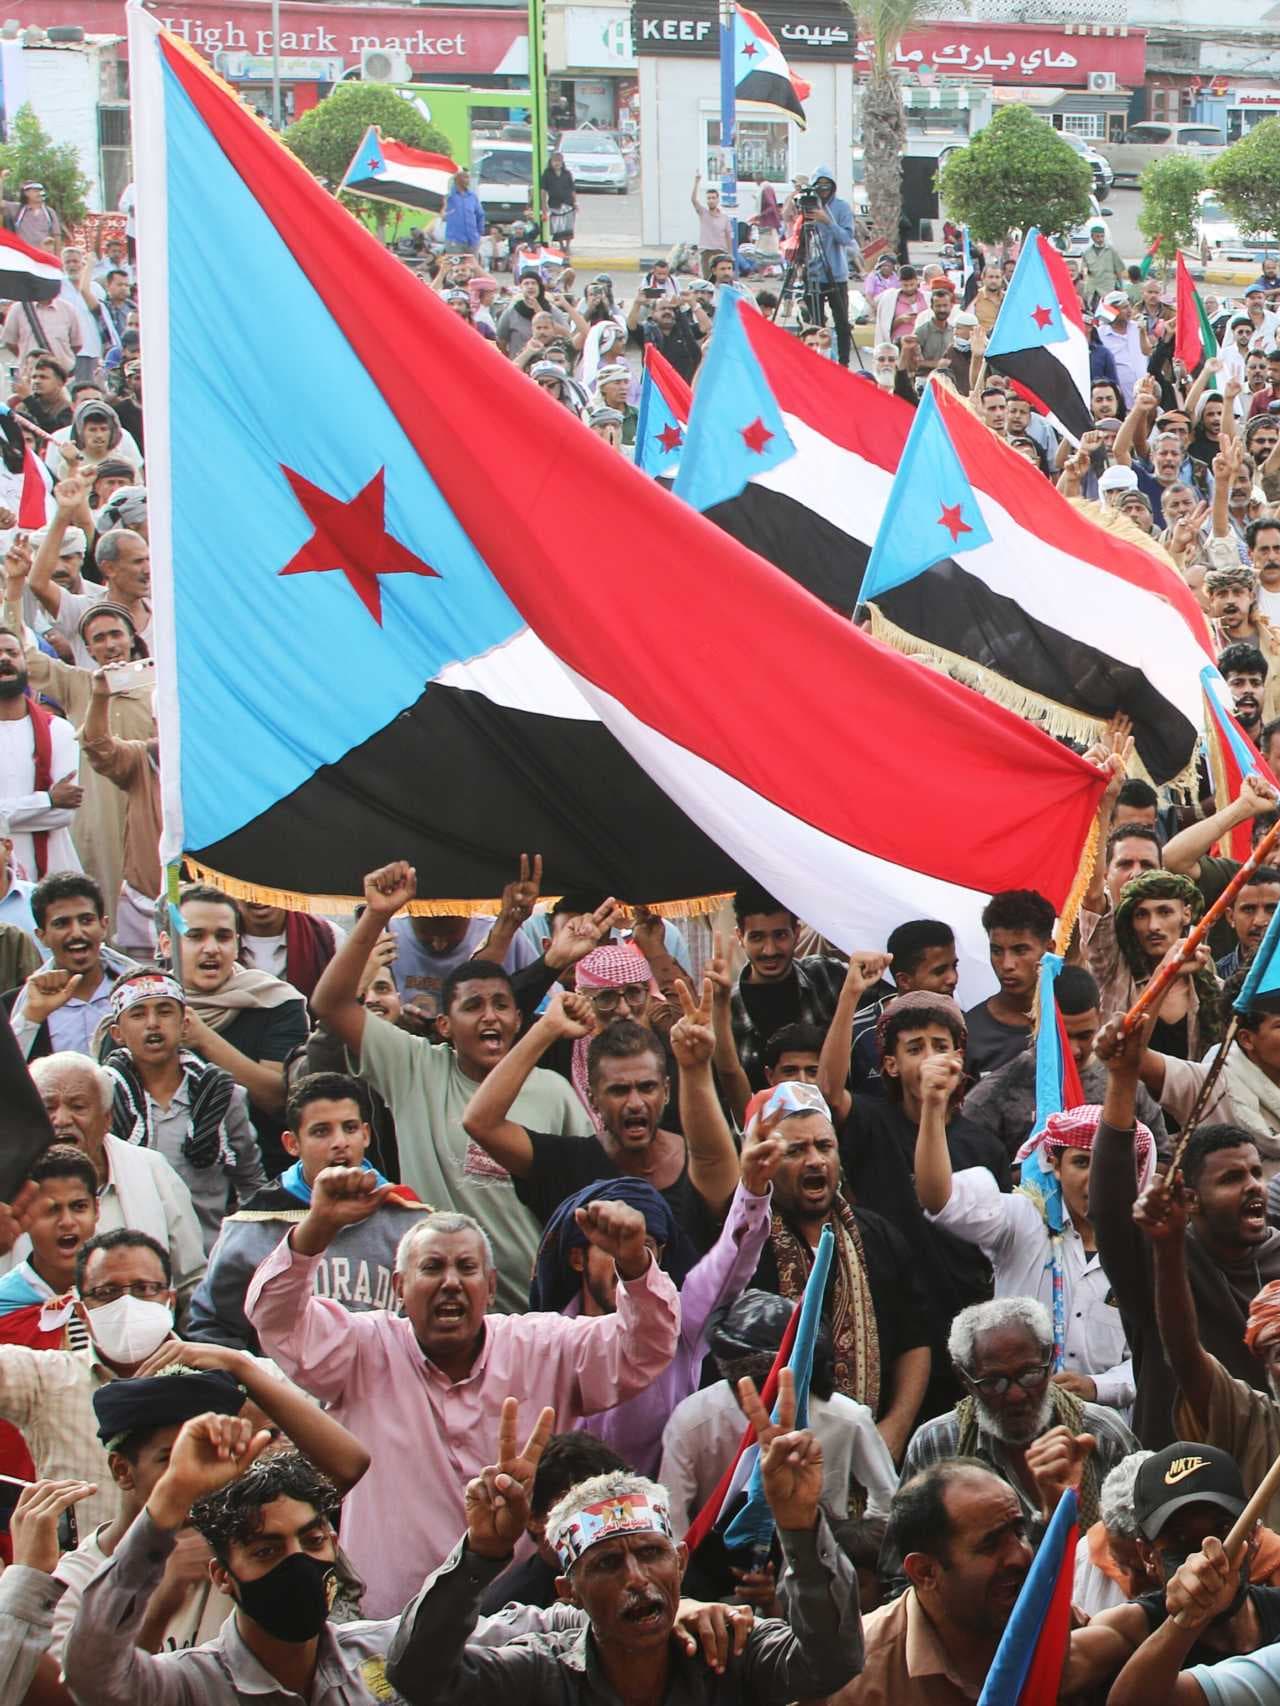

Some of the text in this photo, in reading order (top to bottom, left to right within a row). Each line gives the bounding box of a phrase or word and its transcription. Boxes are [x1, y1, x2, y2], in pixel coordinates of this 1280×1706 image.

[161, 18, 466, 56] High park market
[642, 19, 711, 41] KEEF
[931, 43, 1016, 71] بارك
[1019, 47, 1078, 76] هاي
